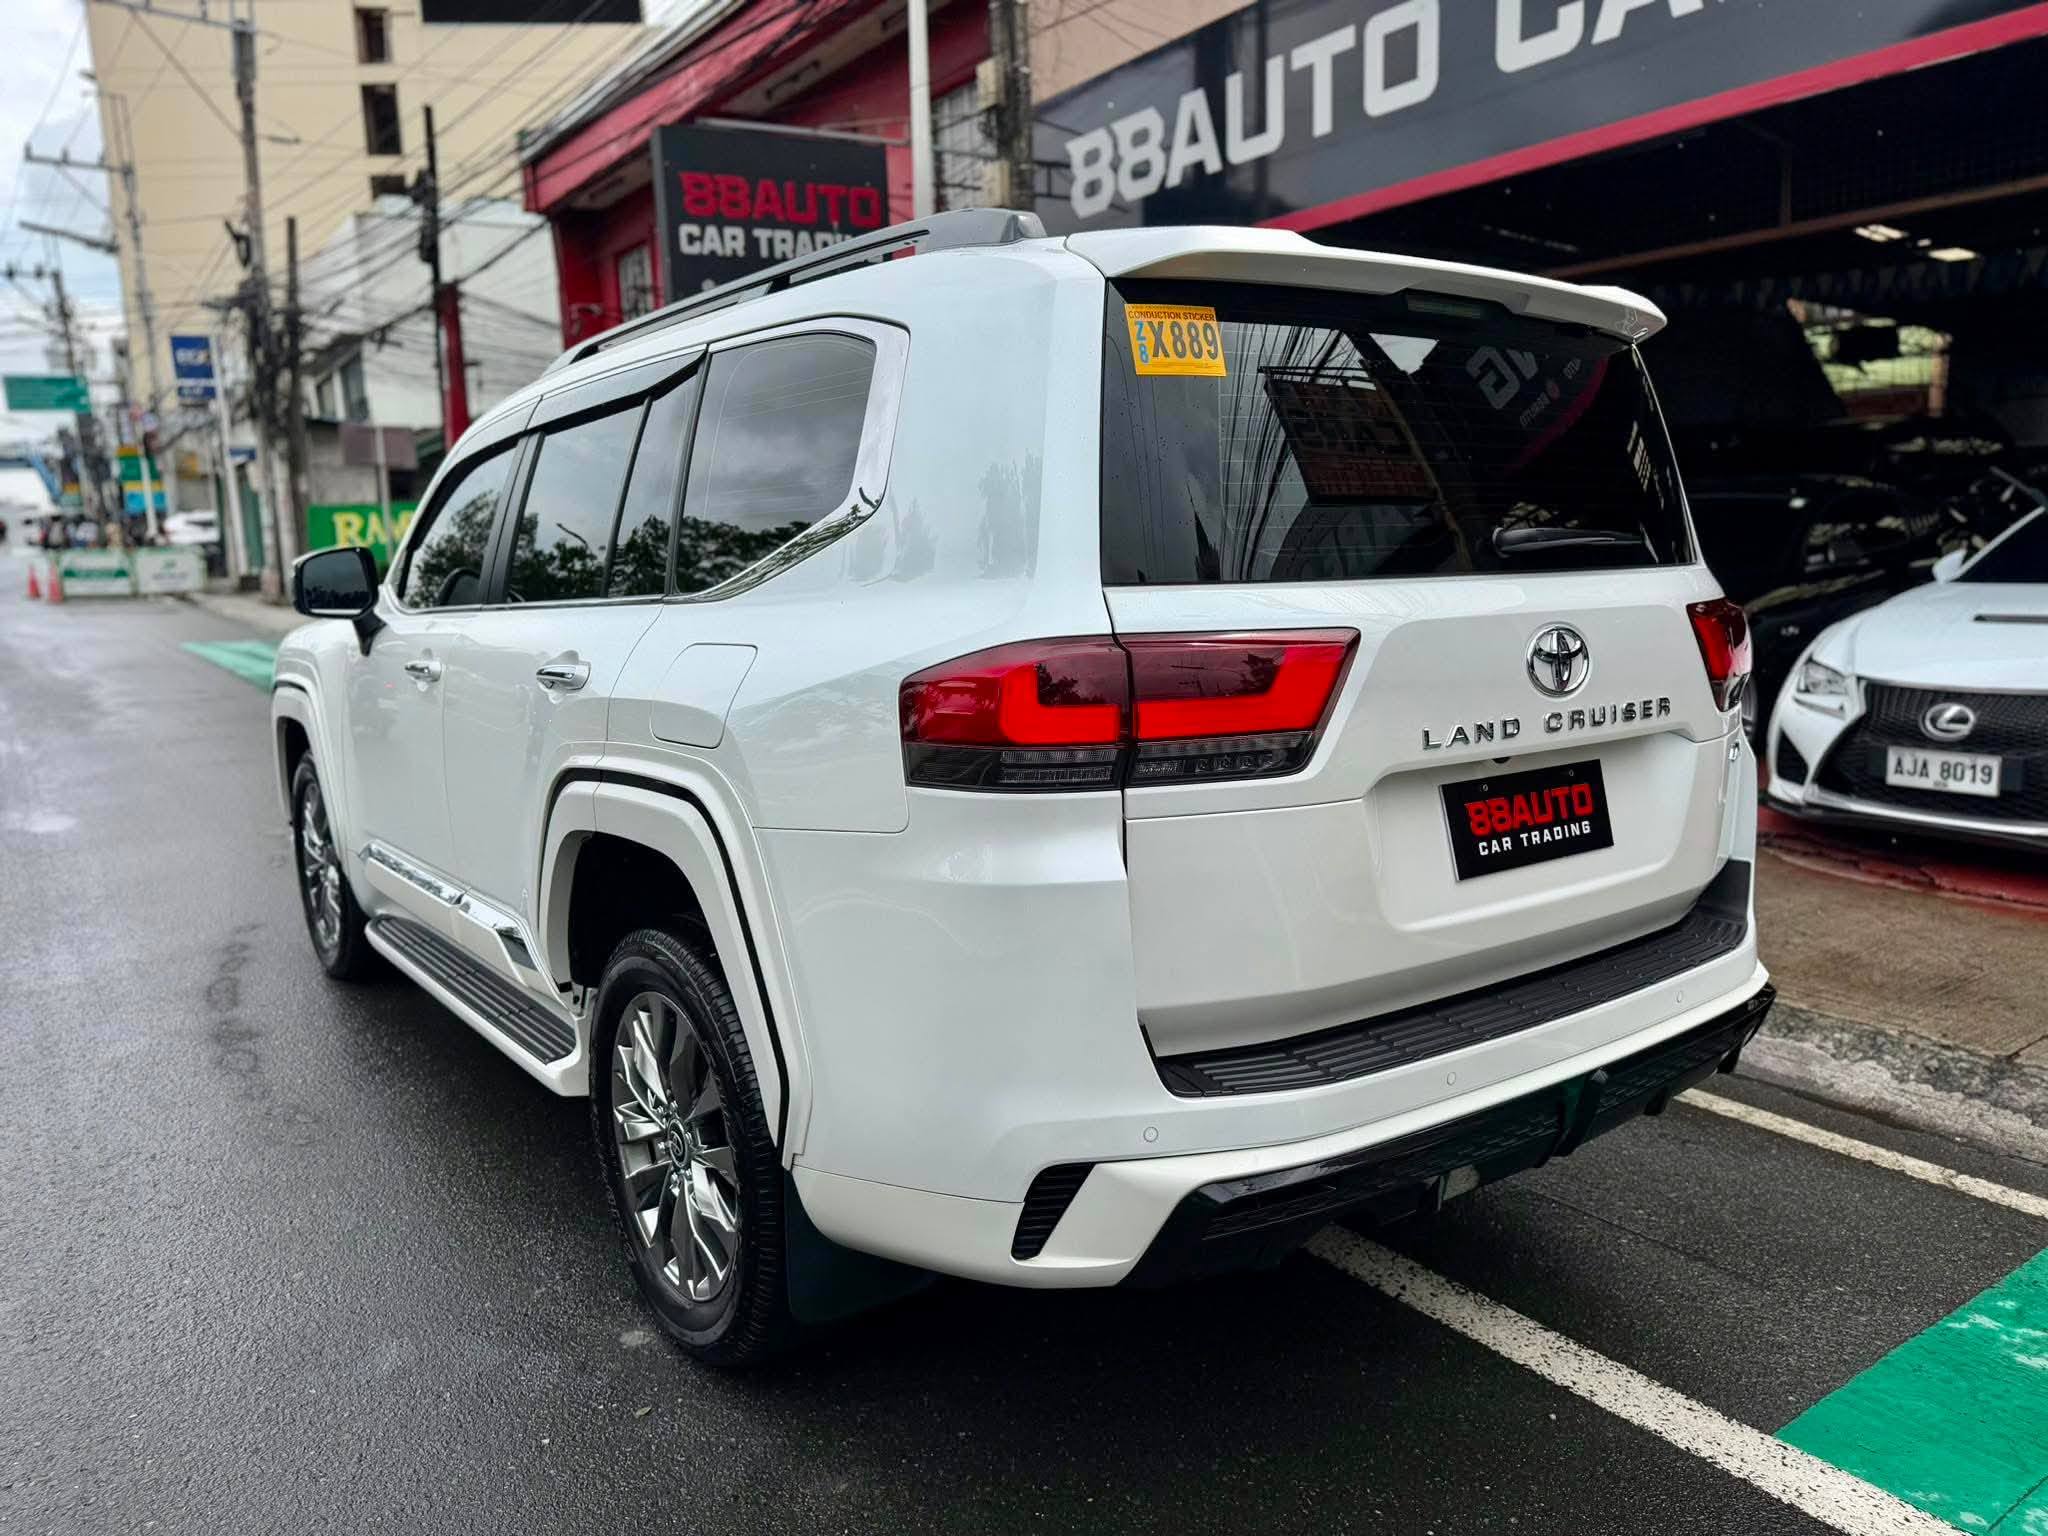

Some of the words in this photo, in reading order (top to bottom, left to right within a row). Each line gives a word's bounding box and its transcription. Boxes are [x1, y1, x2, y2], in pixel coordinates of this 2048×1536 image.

[1065, 0, 1439, 219] 88AUTO
[679, 171, 882, 228] 88AUTO
[679, 223, 745, 258] CAR
[752, 227, 853, 260] TRA
[1128, 310, 1182, 319] CONDUCTION
[1183, 311, 1215, 322] STICKER
[1148, 320, 1219, 360] X889
[1423, 717, 1521, 750] LAND
[1544, 697, 1671, 734] CRUISER
[1894, 756, 1929, 779] AJA
[1940, 761, 1993, 785] 8019
[1464, 783, 1593, 836] 88AUTO
[1479, 837, 1512, 856] CAR
[1520, 820, 1592, 847] TRADING
